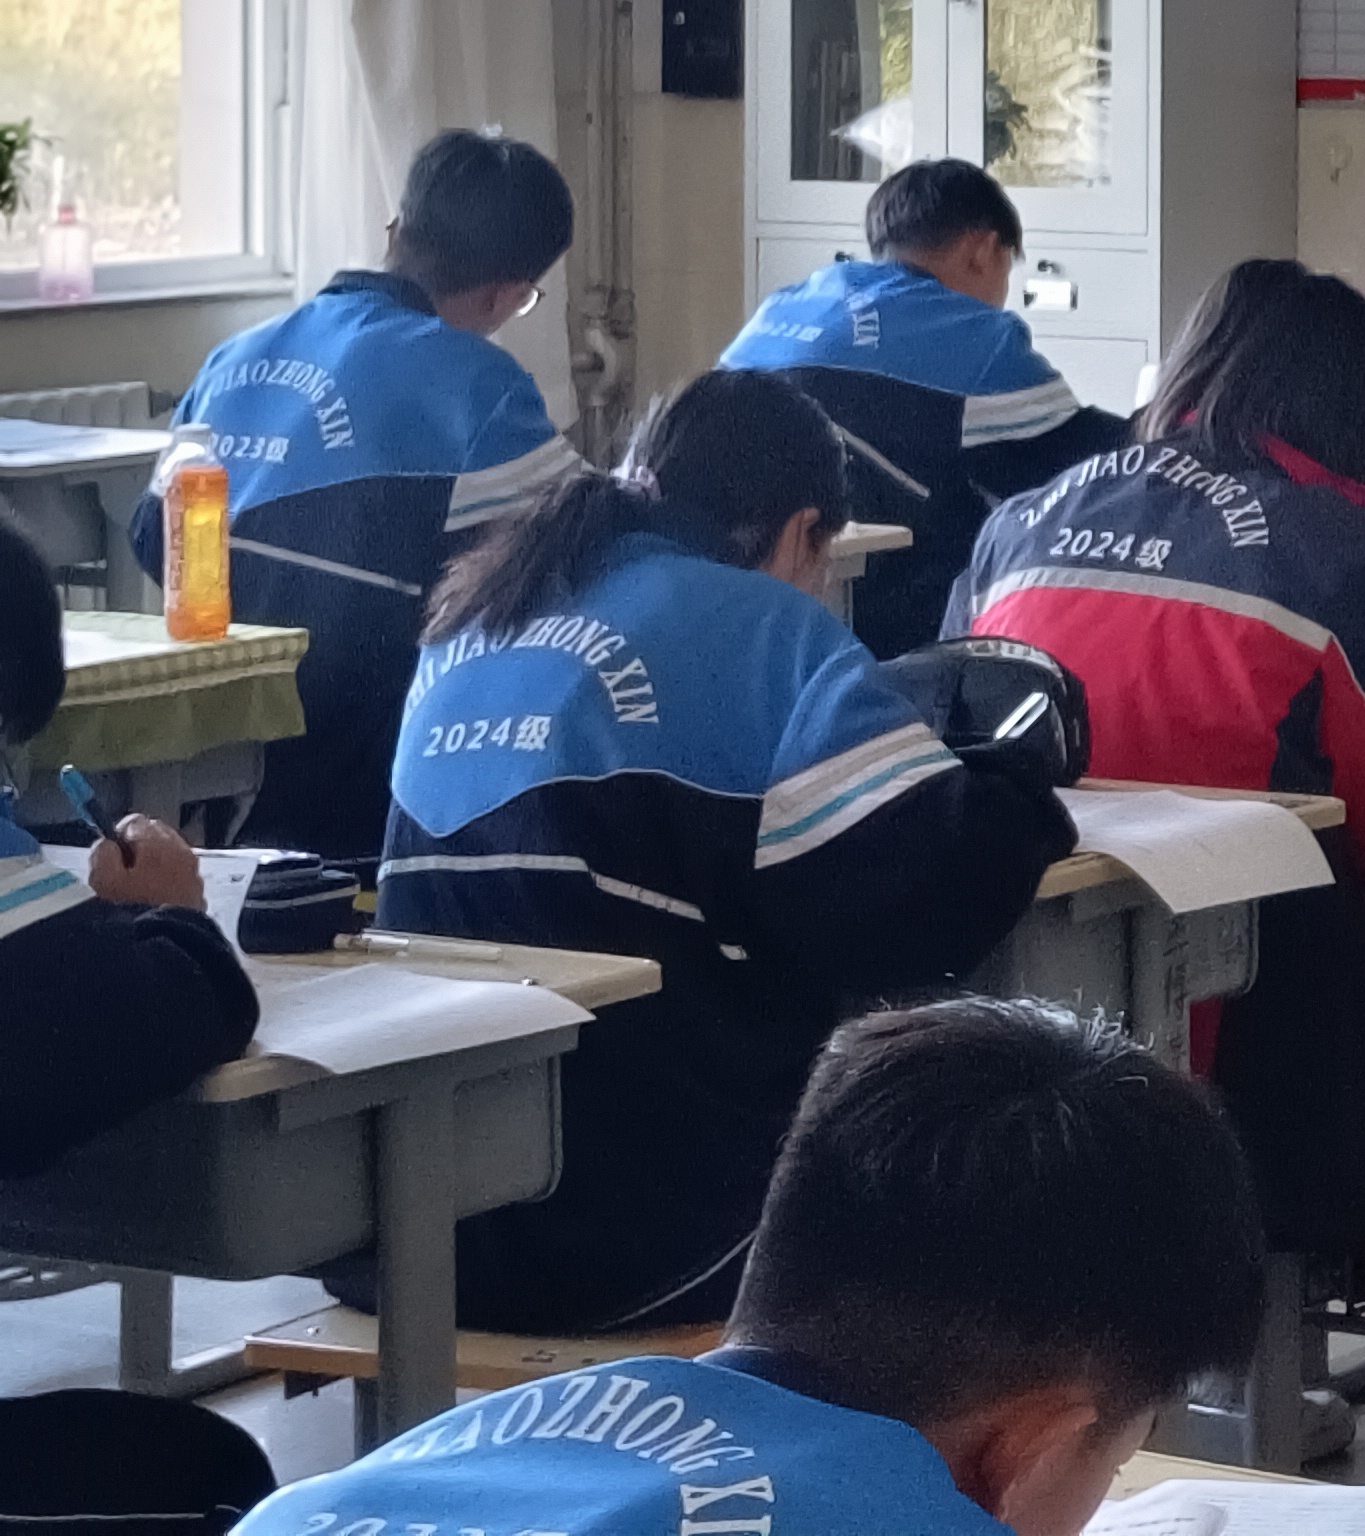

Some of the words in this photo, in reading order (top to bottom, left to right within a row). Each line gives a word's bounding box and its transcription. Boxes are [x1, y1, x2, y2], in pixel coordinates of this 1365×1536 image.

[1221, 498, 1270, 548] XIN
[1049, 526, 1173, 572] 2024级
[597, 656, 660, 724] XIN
[421, 714, 553, 758] 2024级
[679, 1475, 777, 1536] XI
